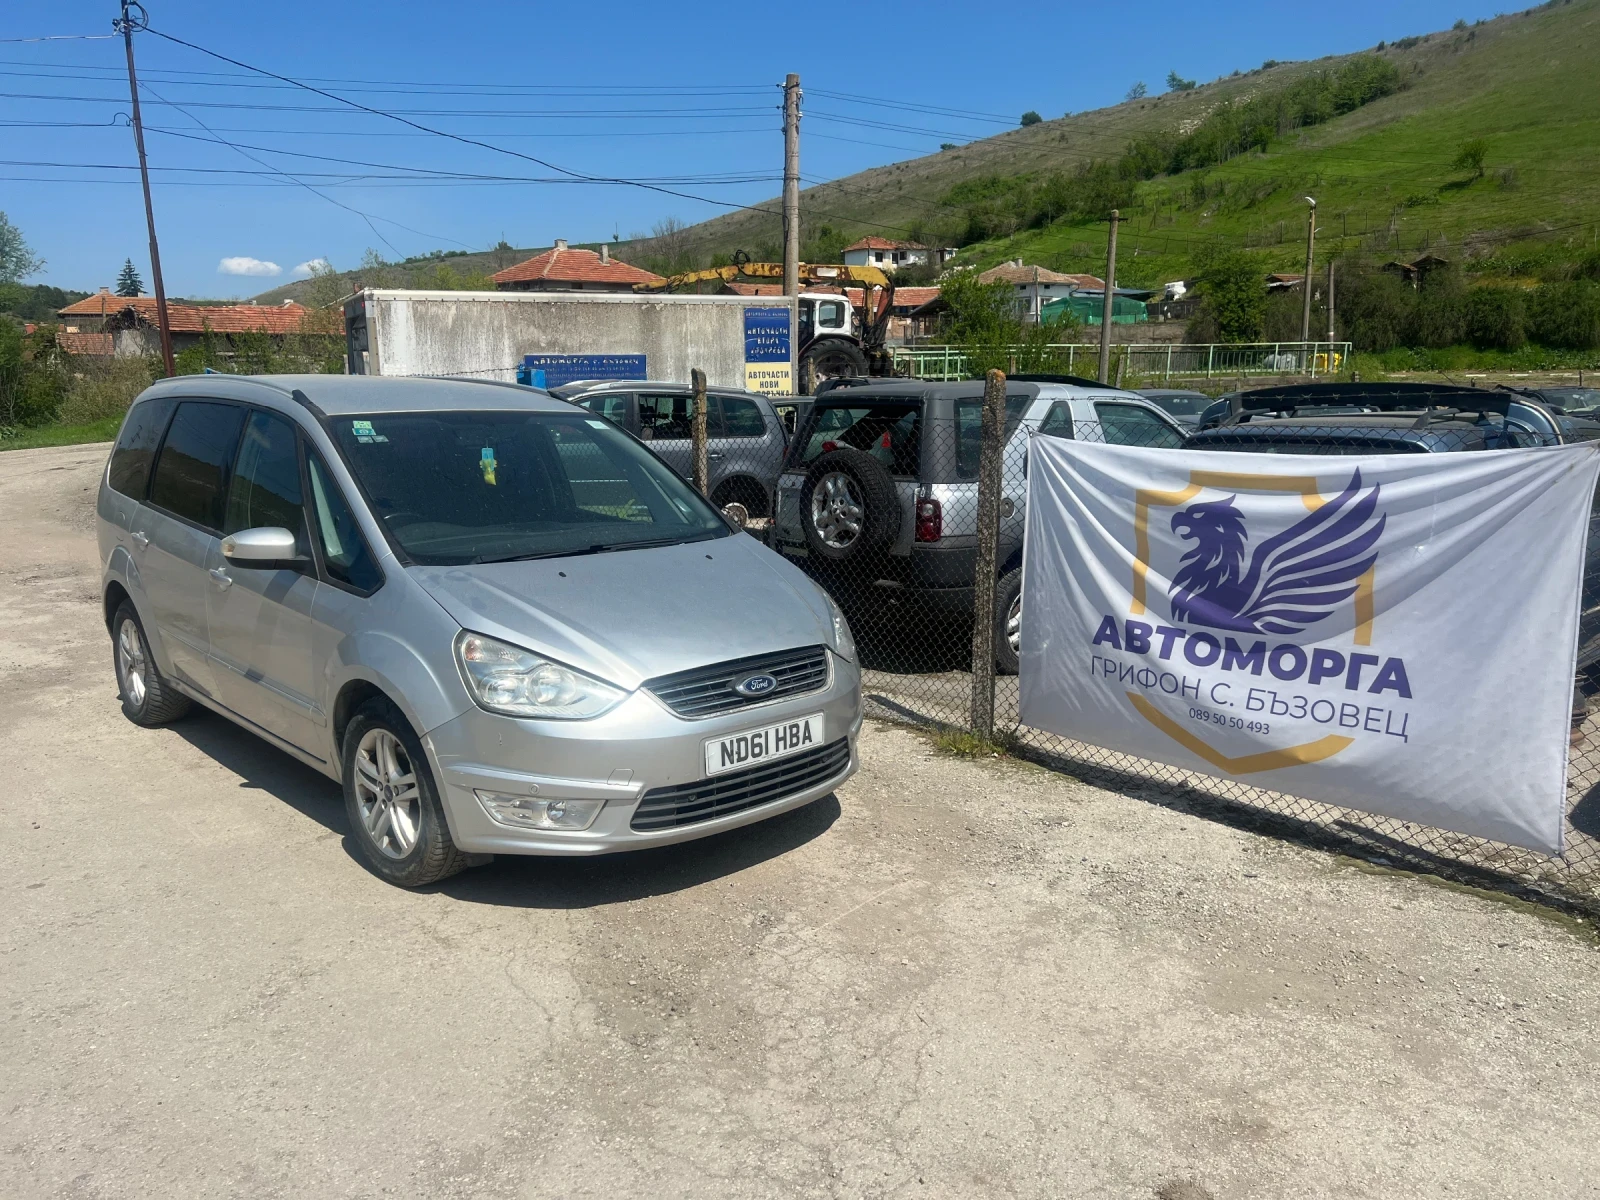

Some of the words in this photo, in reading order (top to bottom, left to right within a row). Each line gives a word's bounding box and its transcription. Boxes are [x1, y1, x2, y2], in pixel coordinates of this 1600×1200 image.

[748, 370, 790, 379] АВТОЧАСТИ
[759, 380, 779, 388] НОВИ
[1092, 614, 1413, 699] АВТОМОРГА
[750, 678, 769, 690] Ford
[1091, 655, 1201, 700] ГРИФОН
[1210, 682, 1235, 707] С.
[1245, 687, 1409, 743] БЪЗОВЕЦ
[1188, 707, 1210, 722] 089
[1212, 711, 1227, 726] 50
[1229, 716, 1244, 730] 50
[1246, 720, 1270, 735] 493
[720, 730, 769, 767] ND61
[774, 719, 813, 753] HBA
